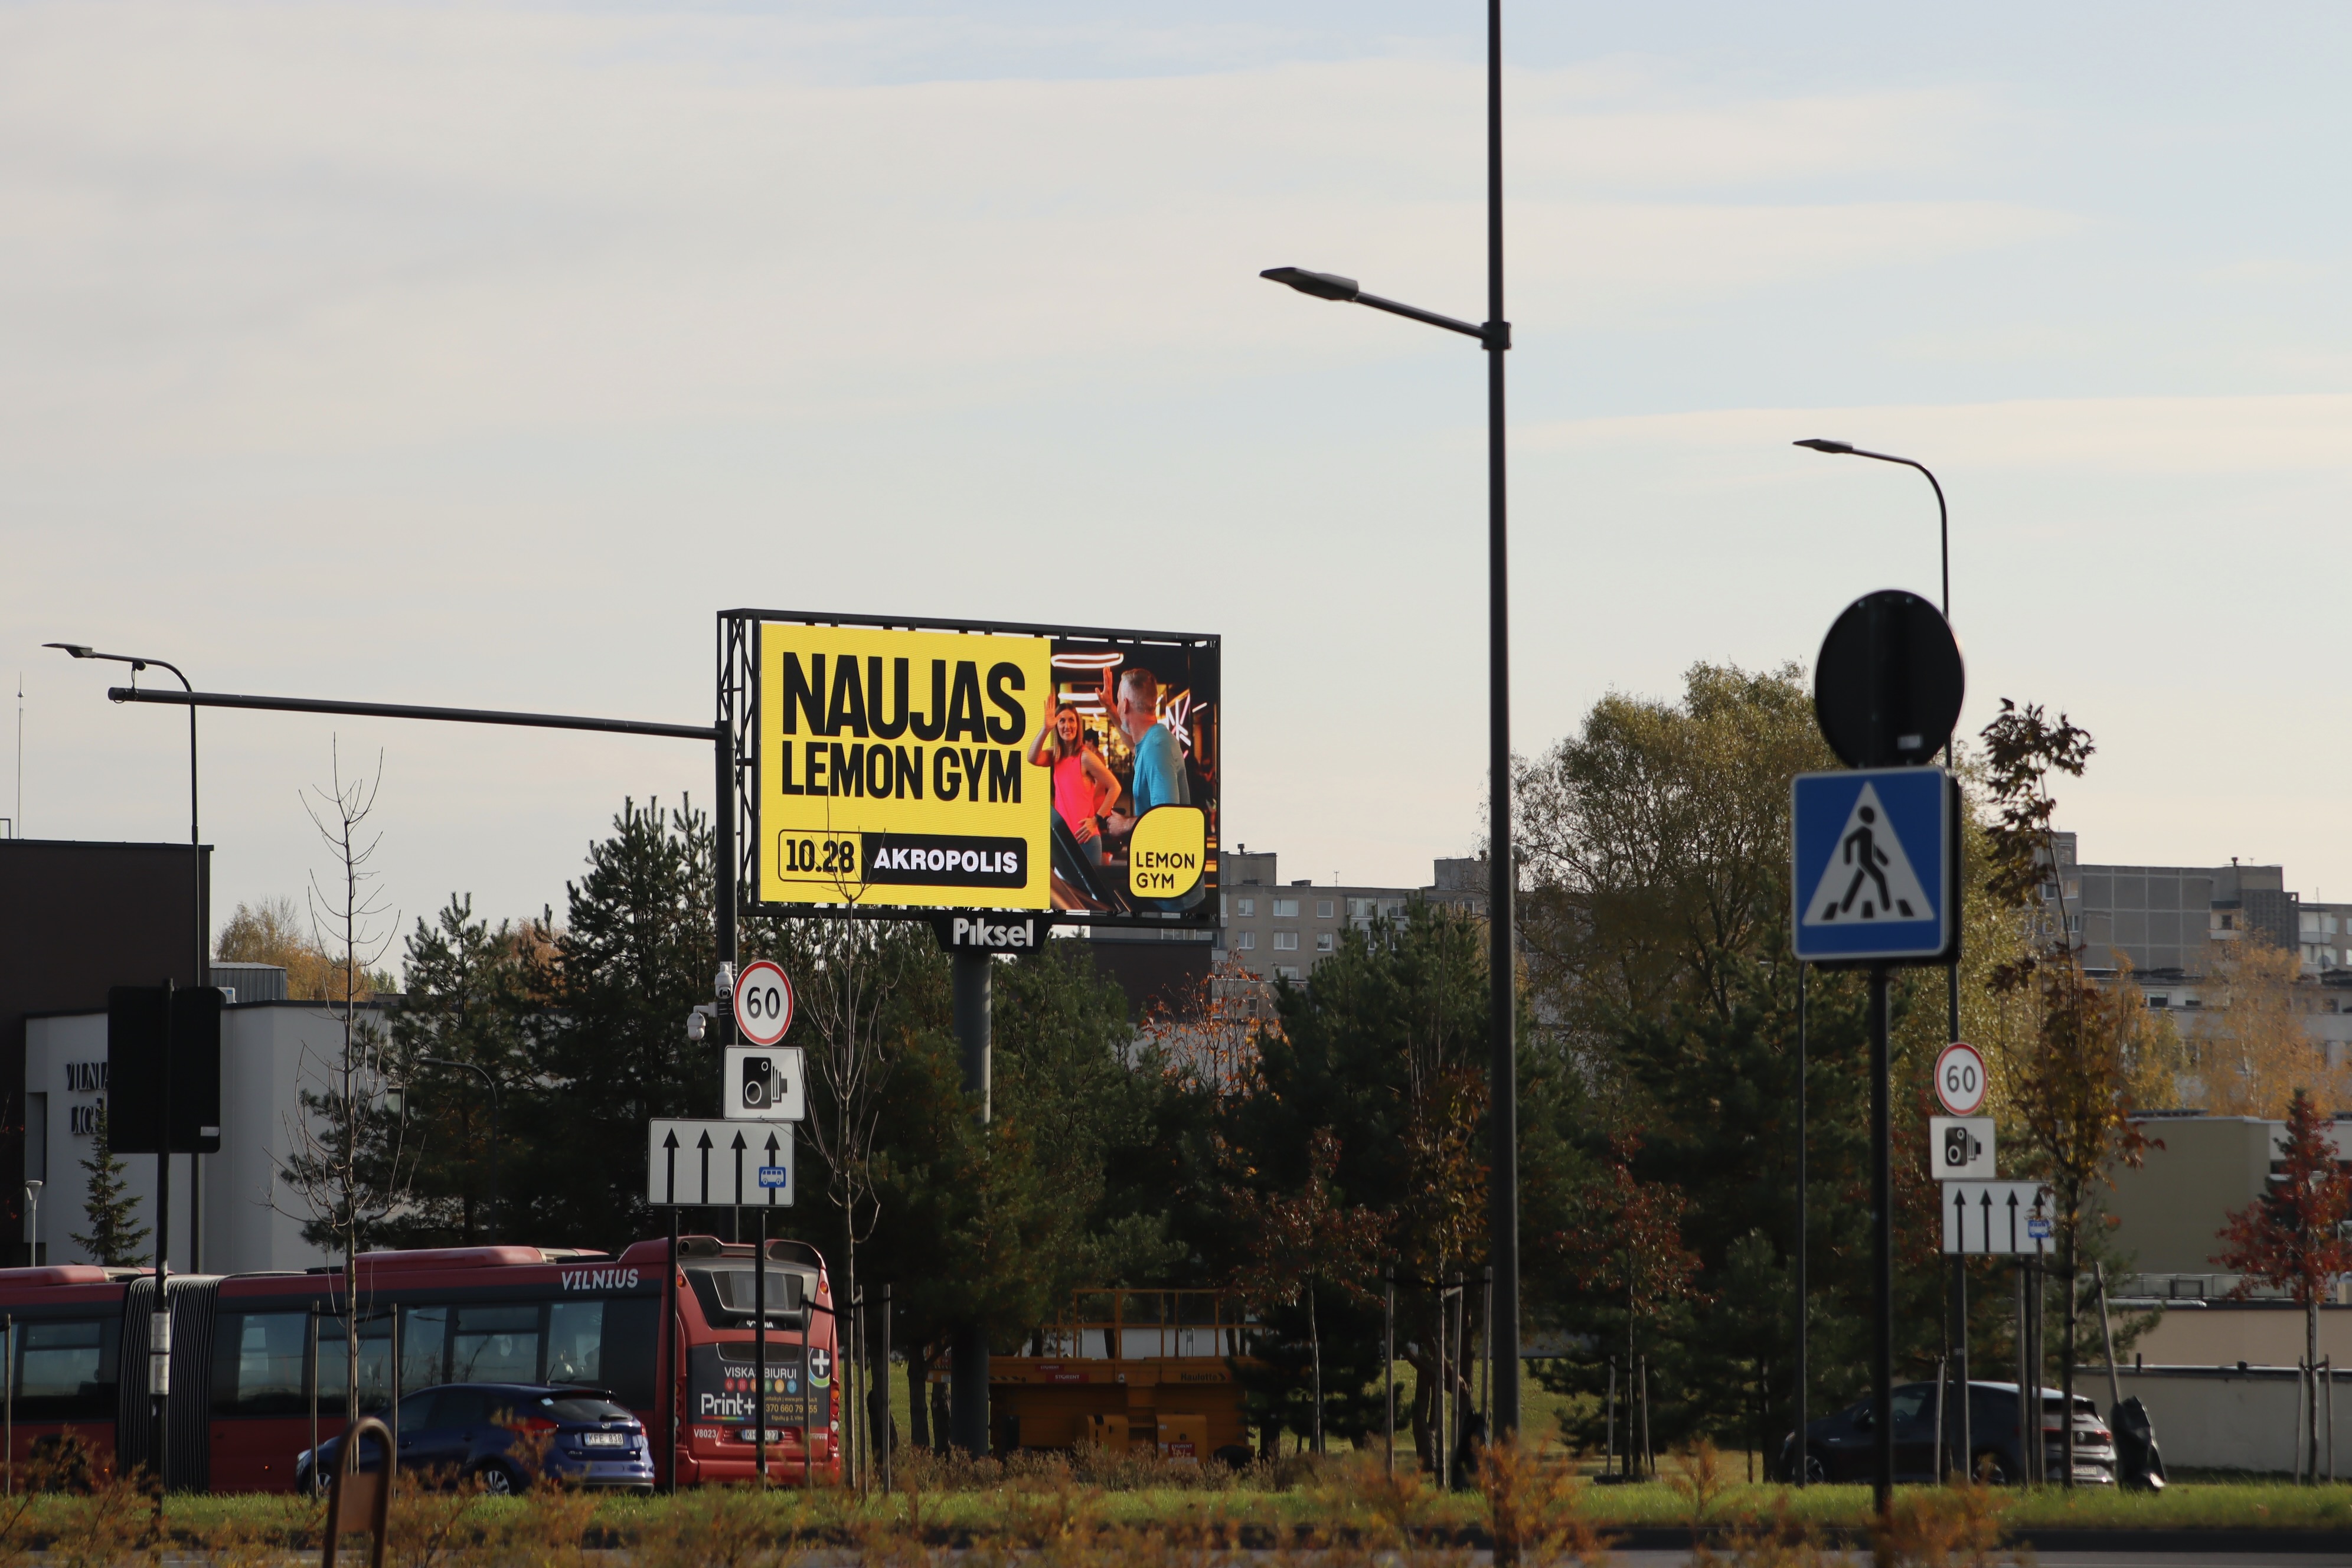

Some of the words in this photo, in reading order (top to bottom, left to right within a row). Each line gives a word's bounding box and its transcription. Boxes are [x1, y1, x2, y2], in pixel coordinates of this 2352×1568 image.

[782, 651, 1026, 746] NAUJAS
[782, 740, 923, 800] LEMON
[933, 746, 1022, 804] GYM
[786, 839, 855, 874] 10.28
[873, 848, 1018, 874] AKROPOLIS
[1136, 851, 1195, 870] LEMON
[1136, 873, 1175, 890] GYM
[953, 917, 1034, 947] Piksel
[747, 986, 780, 1020] 60
[1946, 1065, 1976, 1093] 60
[561, 1268, 639, 1291] VILNIUS
[724, 1366, 756, 1378] VISKA
[765, 1367, 796, 1379] BIURUI
[1180, 1372, 1217, 1381] Haulotte
[780, 1404, 793, 1413] 660
[588, 1433, 605, 1443] KFE
[609, 1433, 622, 1443] 838
[694, 1429, 717, 1439] V8023
